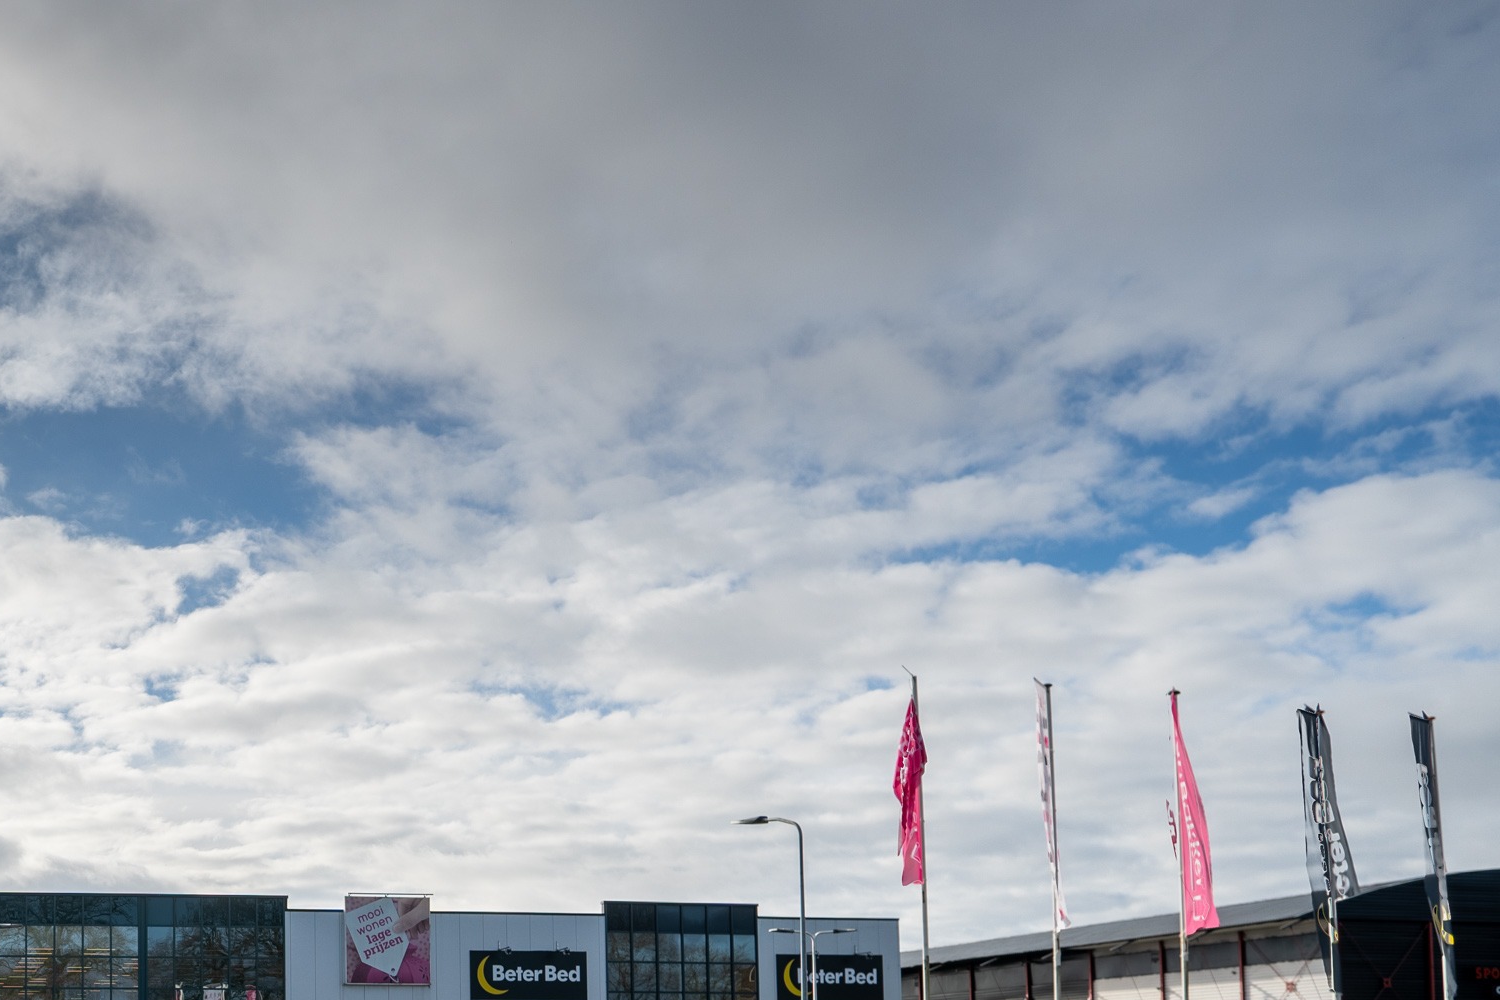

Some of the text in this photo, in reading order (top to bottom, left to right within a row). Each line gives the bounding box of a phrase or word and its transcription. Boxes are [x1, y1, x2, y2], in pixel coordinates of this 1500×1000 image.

[357, 905, 384, 923] mooi
[356, 916, 393, 935] wonen
[366, 929, 391, 945] lage
[363, 936, 403, 959] prijzen
[492, 964, 581, 982] Beter Bed
[844, 968, 878, 985] Bed
